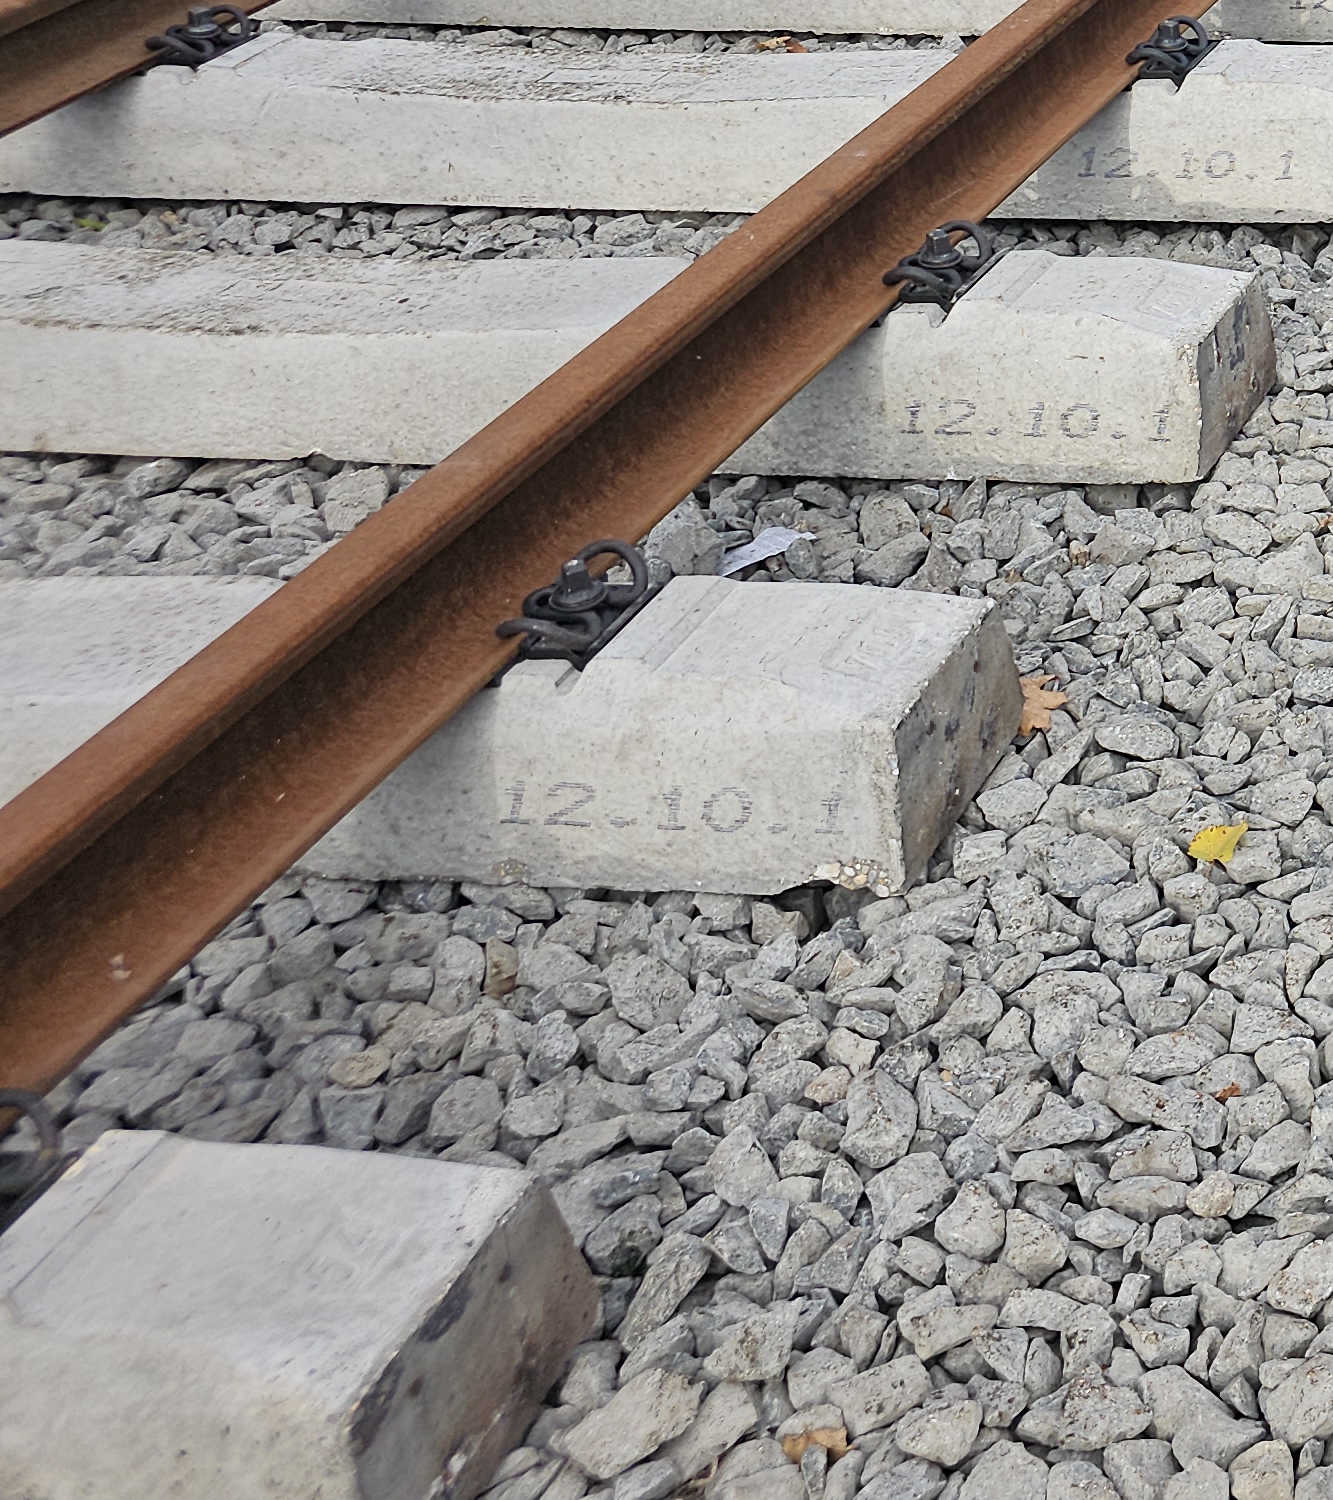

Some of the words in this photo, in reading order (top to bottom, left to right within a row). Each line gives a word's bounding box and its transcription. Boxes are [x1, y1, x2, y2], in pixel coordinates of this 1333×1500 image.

[1078, 146, 1294, 181] 12.10.1
[900, 399, 1172, 442] 12.10.1
[500, 780, 844, 834] 12.10.1
